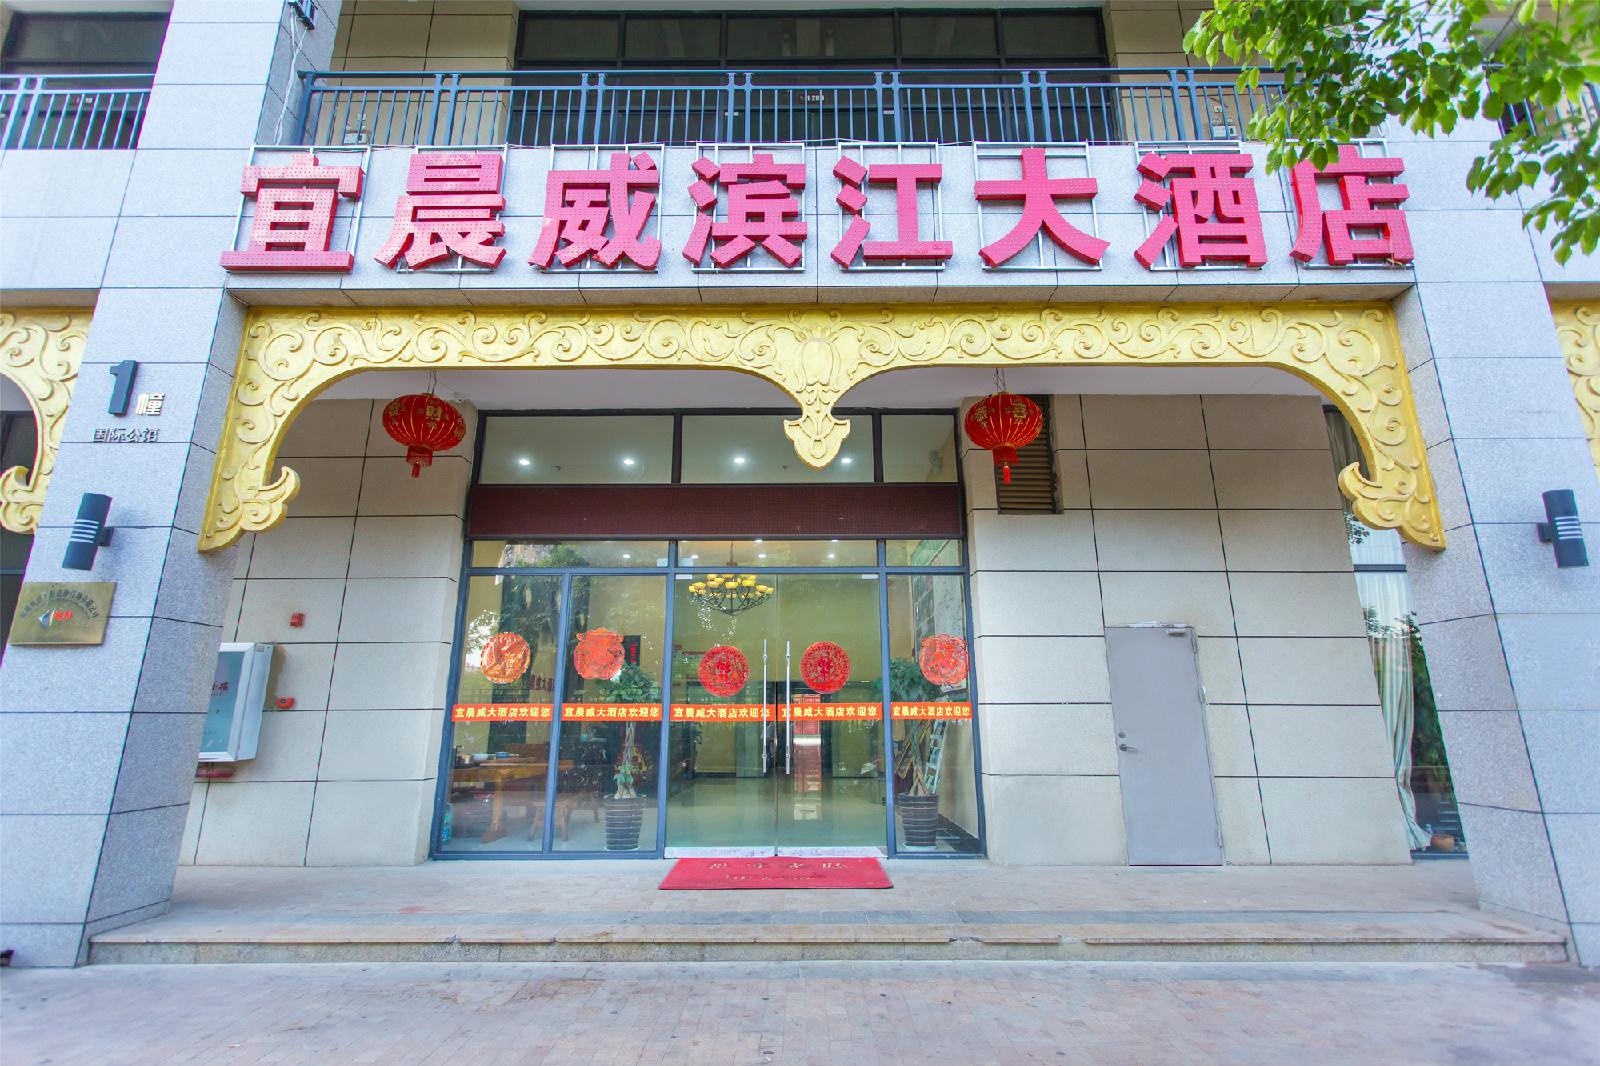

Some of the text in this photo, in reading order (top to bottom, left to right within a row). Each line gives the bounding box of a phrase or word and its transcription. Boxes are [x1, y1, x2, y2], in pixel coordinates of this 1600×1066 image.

[220, 144, 1415, 273] 宜晨威滨江大酒店
[94, 427, 160, 442] 国际公馆
[455, 706, 551, 718] 宜晨威大酒店欢迎您
[564, 706, 660, 718] 宜晨威大酒店欢迎您
[892, 705, 970, 717] 宜晨威大酒店欢迎您
